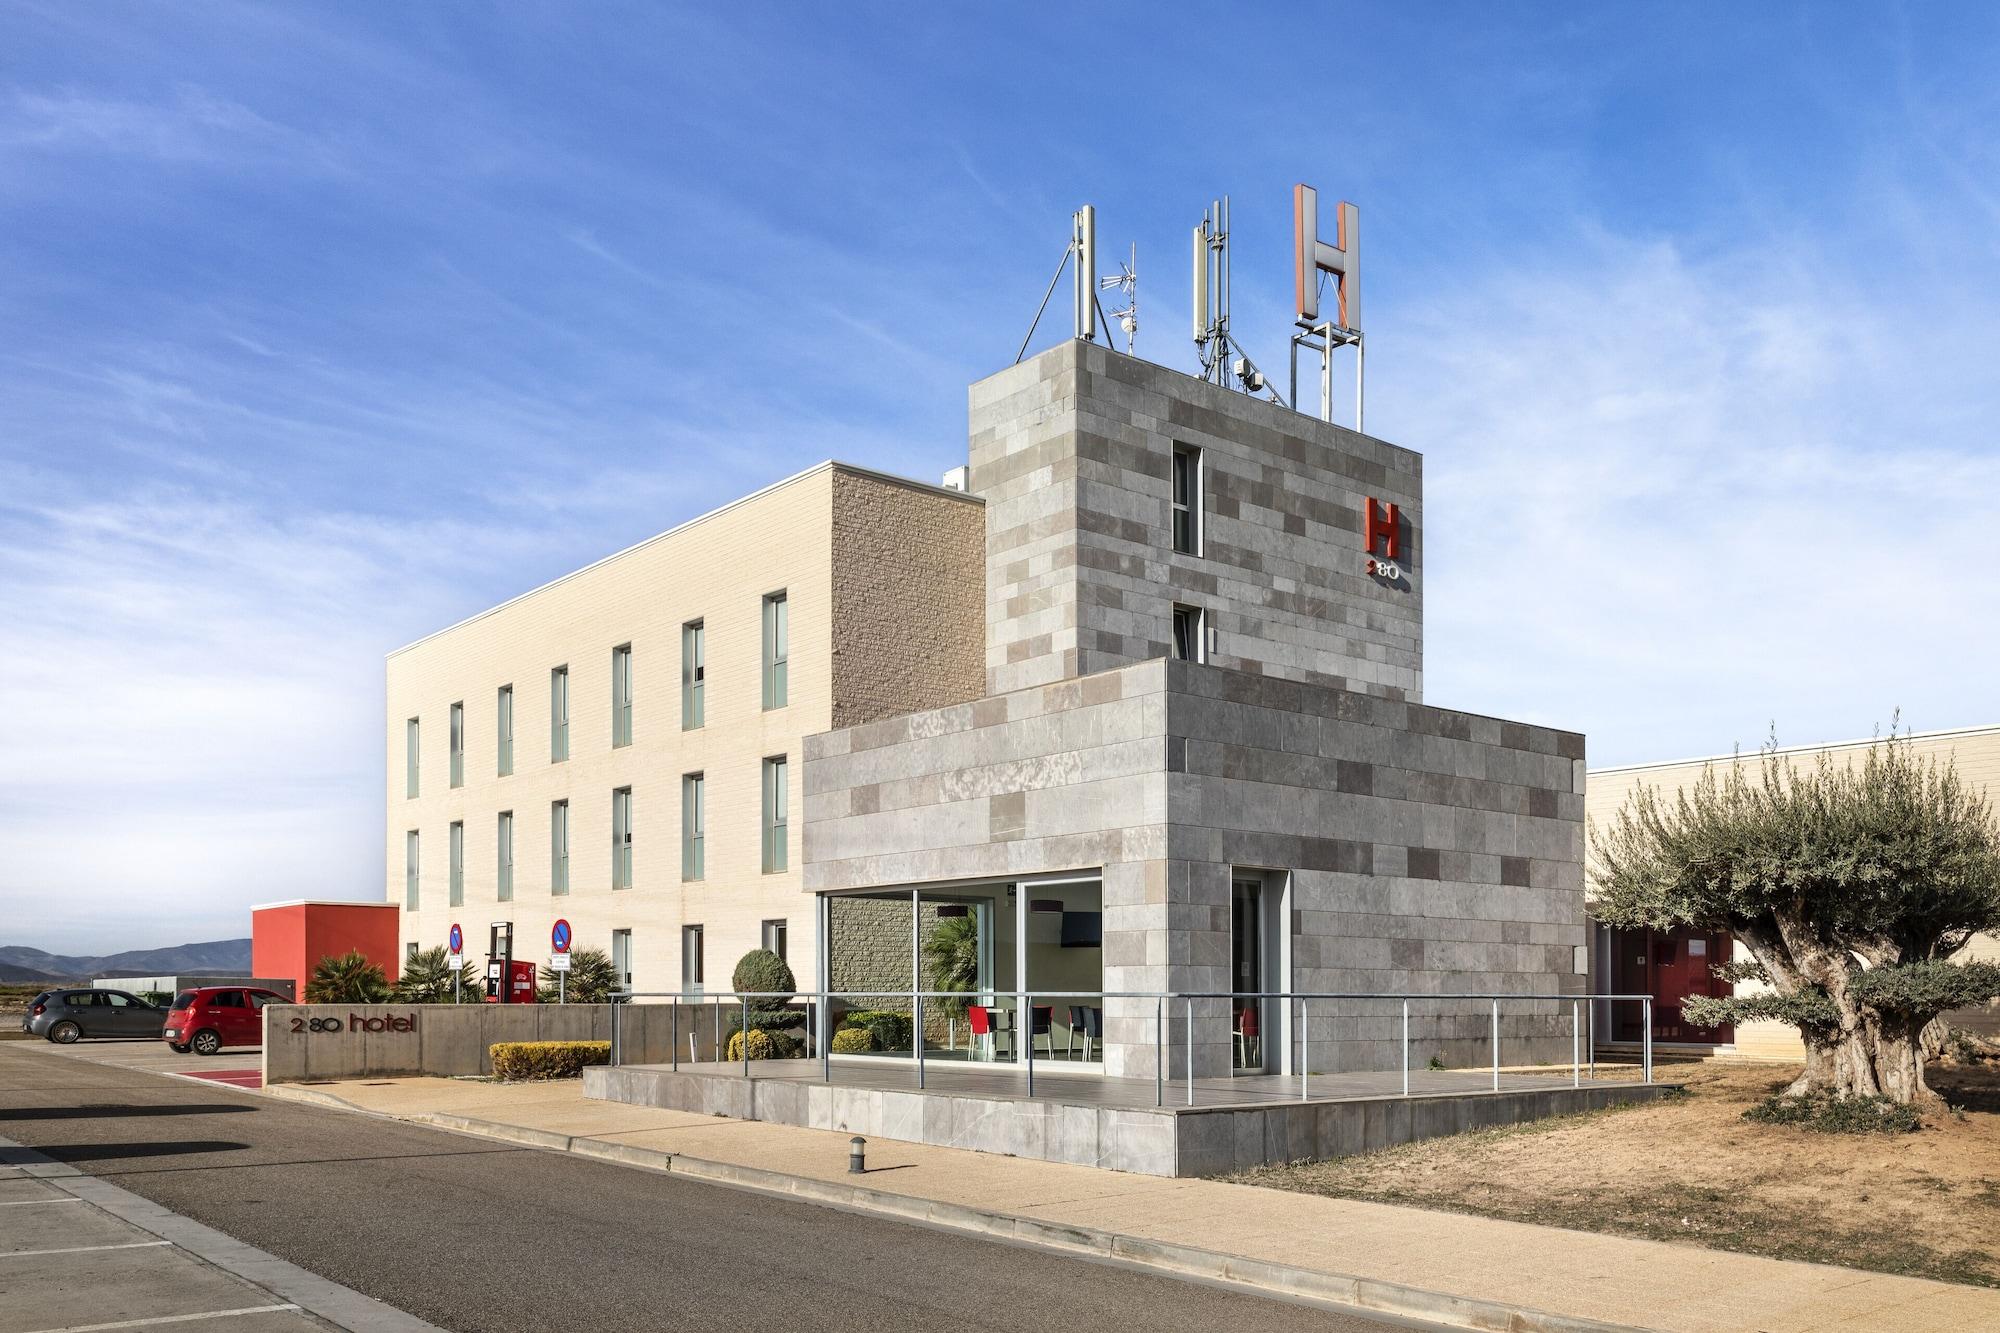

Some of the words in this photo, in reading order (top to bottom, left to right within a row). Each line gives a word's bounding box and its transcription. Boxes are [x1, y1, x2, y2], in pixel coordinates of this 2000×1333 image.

[1295, 184, 1361, 332] H
[1365, 496, 1399, 559] H
[1366, 560, 1399, 579] 280
[349, 1012, 415, 1033] hotel
